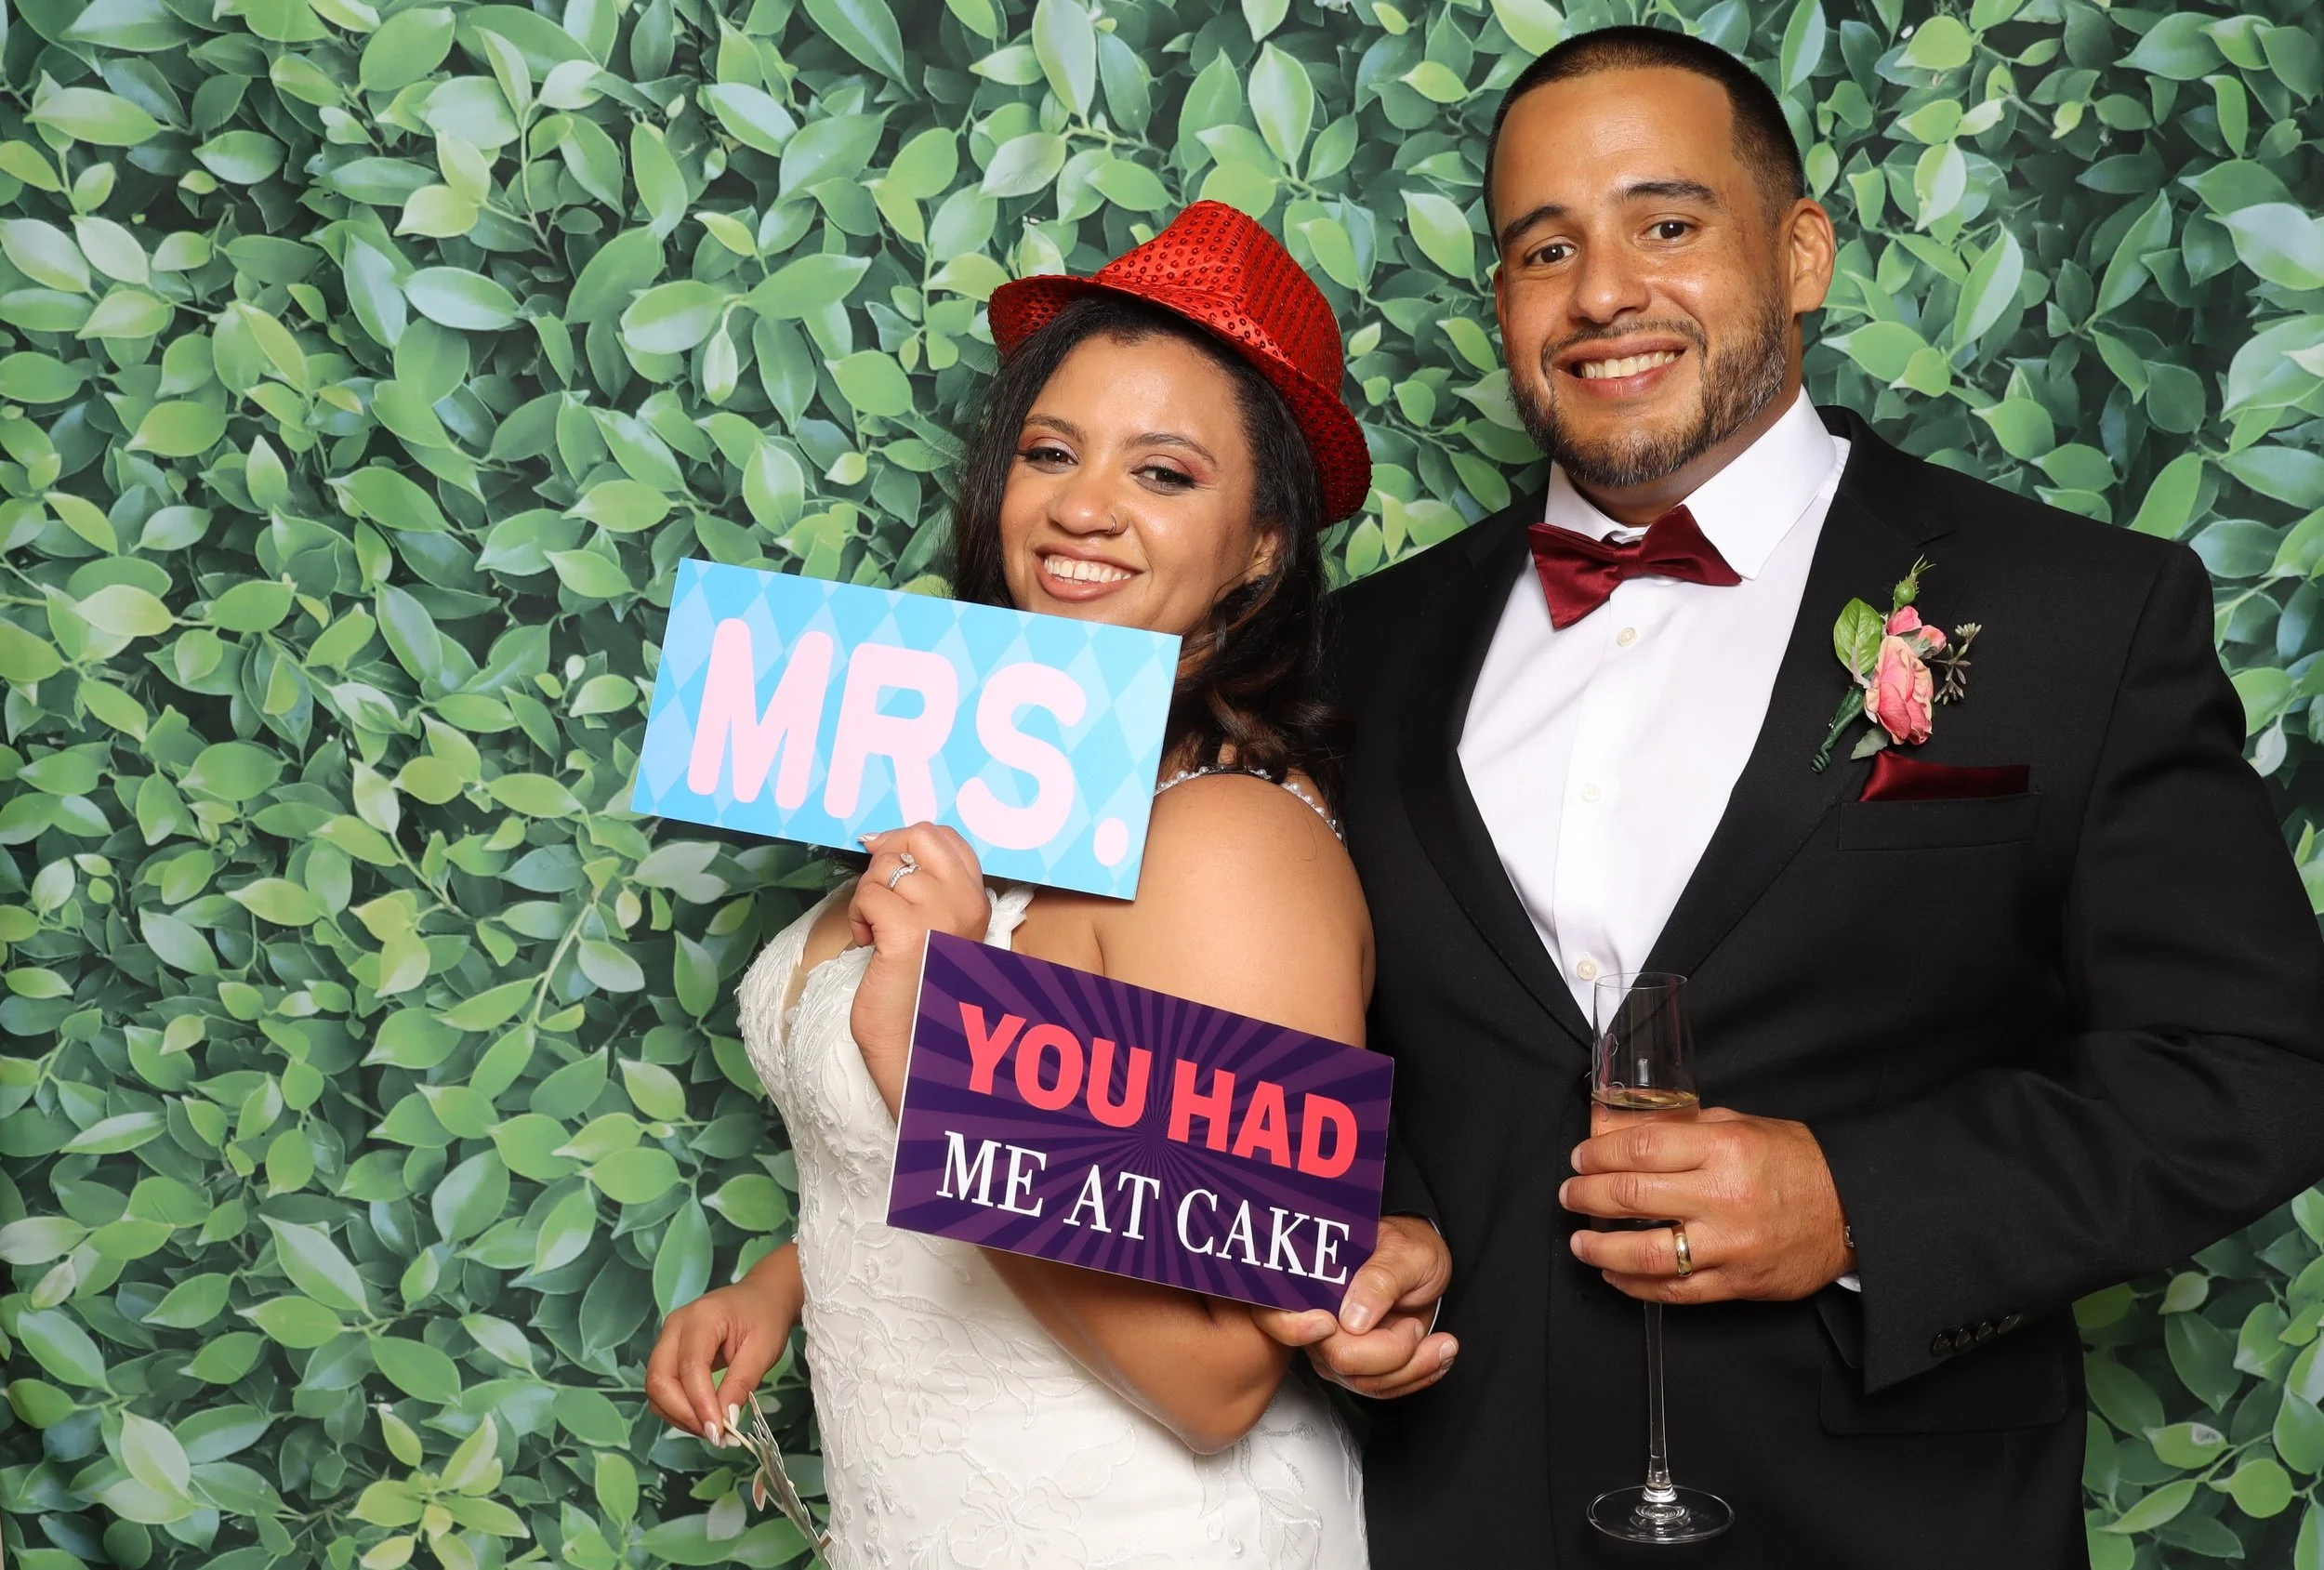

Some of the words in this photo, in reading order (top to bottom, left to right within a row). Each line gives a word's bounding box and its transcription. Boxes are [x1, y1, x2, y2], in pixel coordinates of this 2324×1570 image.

[688, 618, 1129, 866] MRS.
[959, 1002, 1152, 1128] YOU
[1168, 1059, 1357, 1179] HAD
[936, 1130, 1048, 1218] ME
[1063, 1164, 1161, 1241] AT
[1177, 1188, 1350, 1286] CAKE
